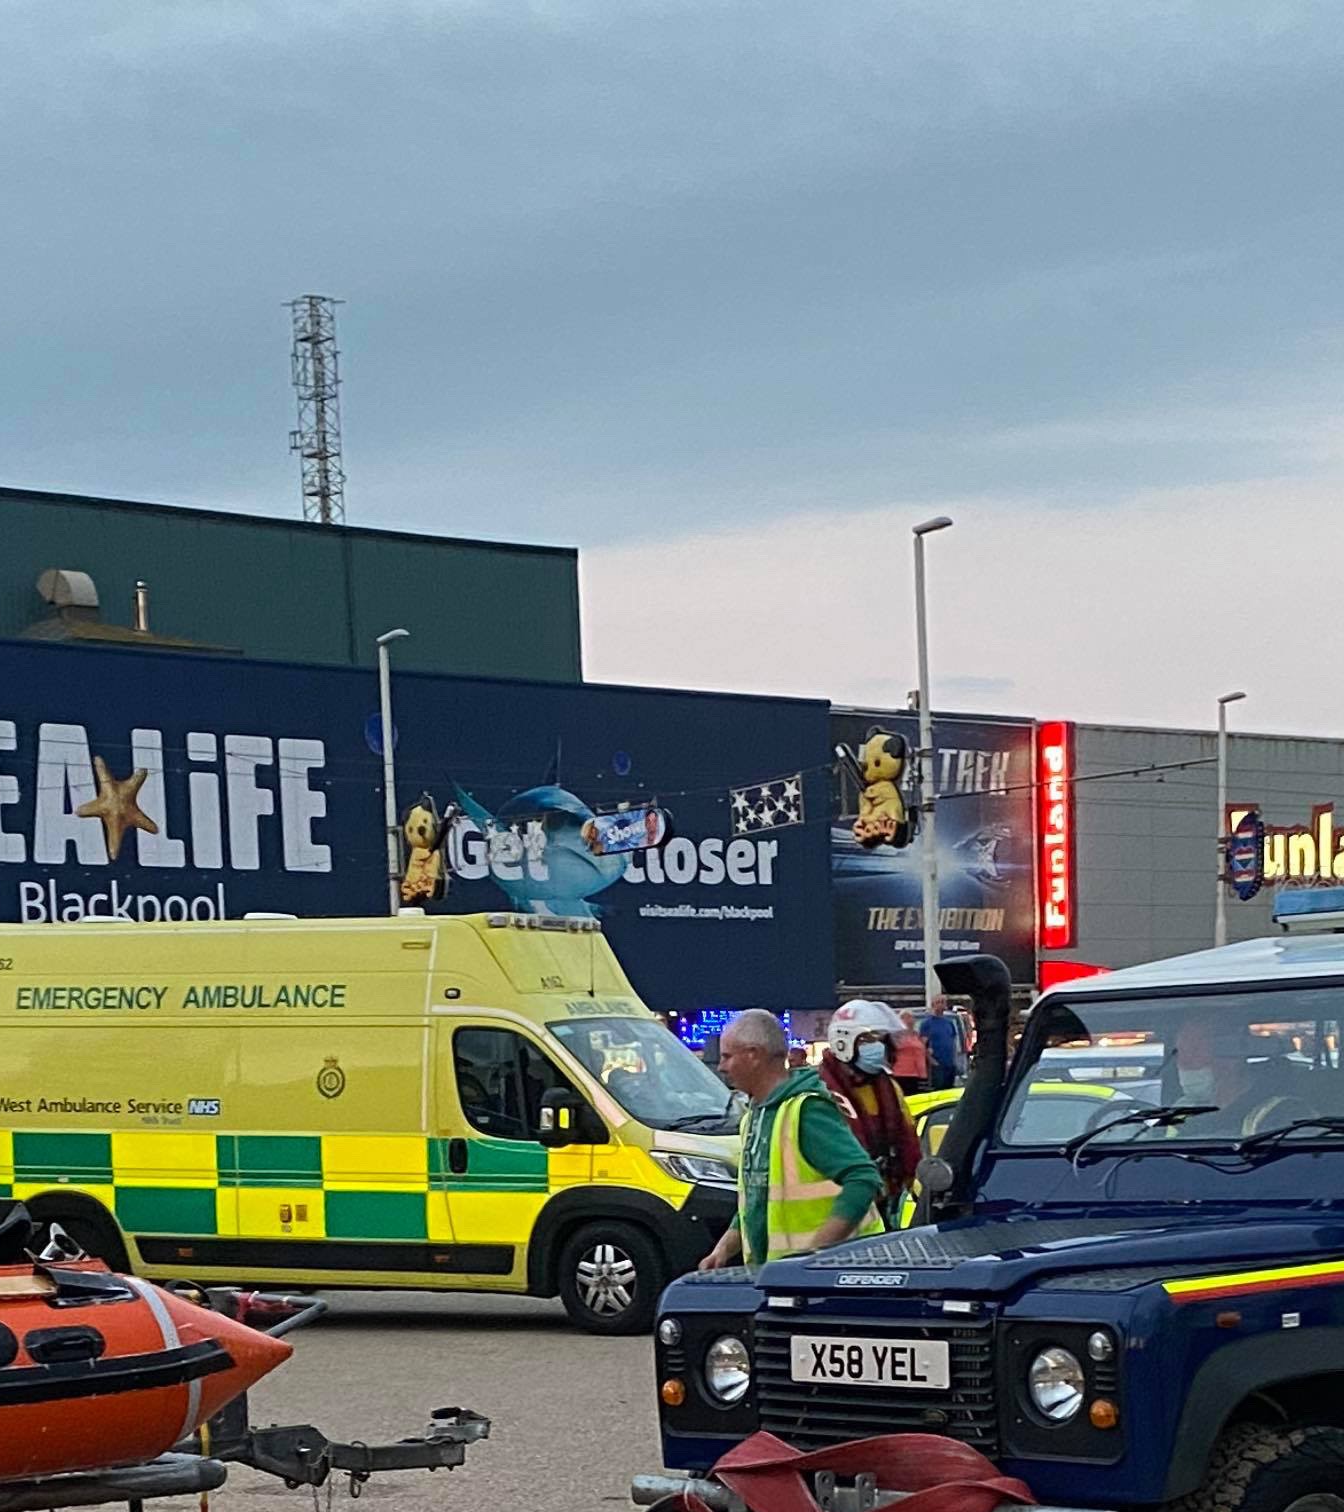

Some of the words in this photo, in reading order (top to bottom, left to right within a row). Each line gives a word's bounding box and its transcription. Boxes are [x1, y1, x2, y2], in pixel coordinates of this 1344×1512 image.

[447, 816, 549, 881] Get
[1044, 745, 1067, 928] Funland
[19, 878, 225, 923] Blackpool
[902, 907, 1005, 932] EXIBITION
[16, 986, 168, 1010] EMERGENCY
[182, 984, 347, 1009] AMBULANCE
[38, 1097, 121, 1114] Ambulance
[127, 1098, 182, 1114] Service
[188, 1099, 220, 1115] NHS
[839, 1274, 904, 1285] DEFENDER
[810, 1343, 864, 1379] X58
[872, 1345, 928, 1383] YEL
